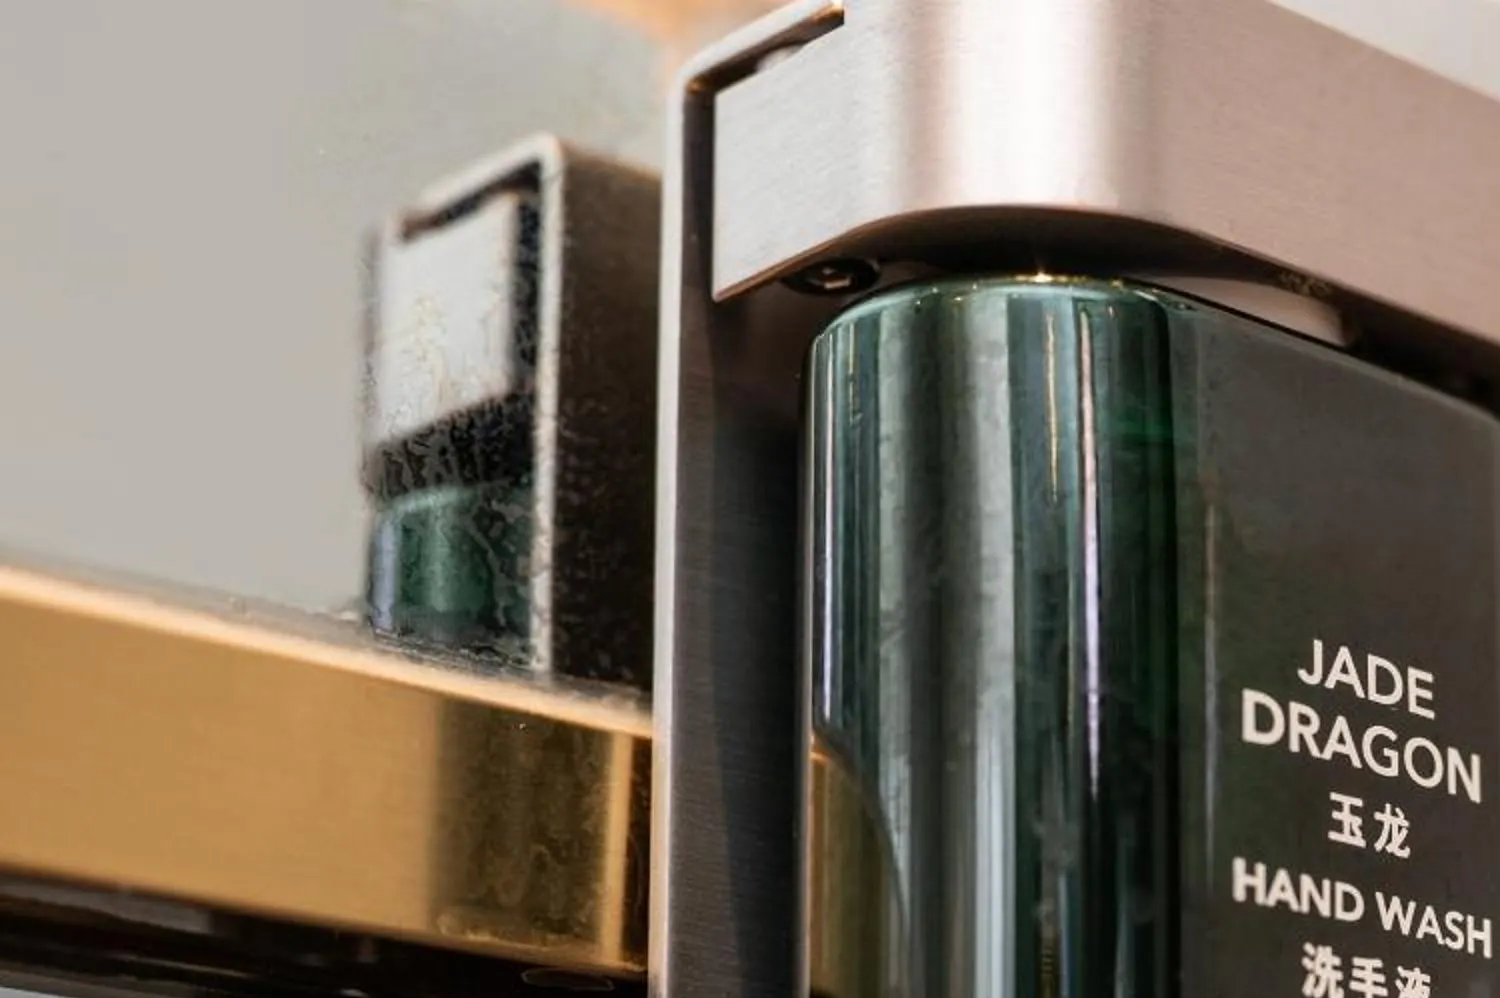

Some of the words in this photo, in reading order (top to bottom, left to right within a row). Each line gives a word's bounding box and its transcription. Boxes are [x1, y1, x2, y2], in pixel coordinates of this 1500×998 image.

[1298, 639, 1435, 720] JADE
[1241, 688, 1482, 804] DRAGON
[1328, 792, 1411, 859] 玉龙
[1232, 857, 1366, 922] HAND
[1375, 892, 1492, 959] WASH
